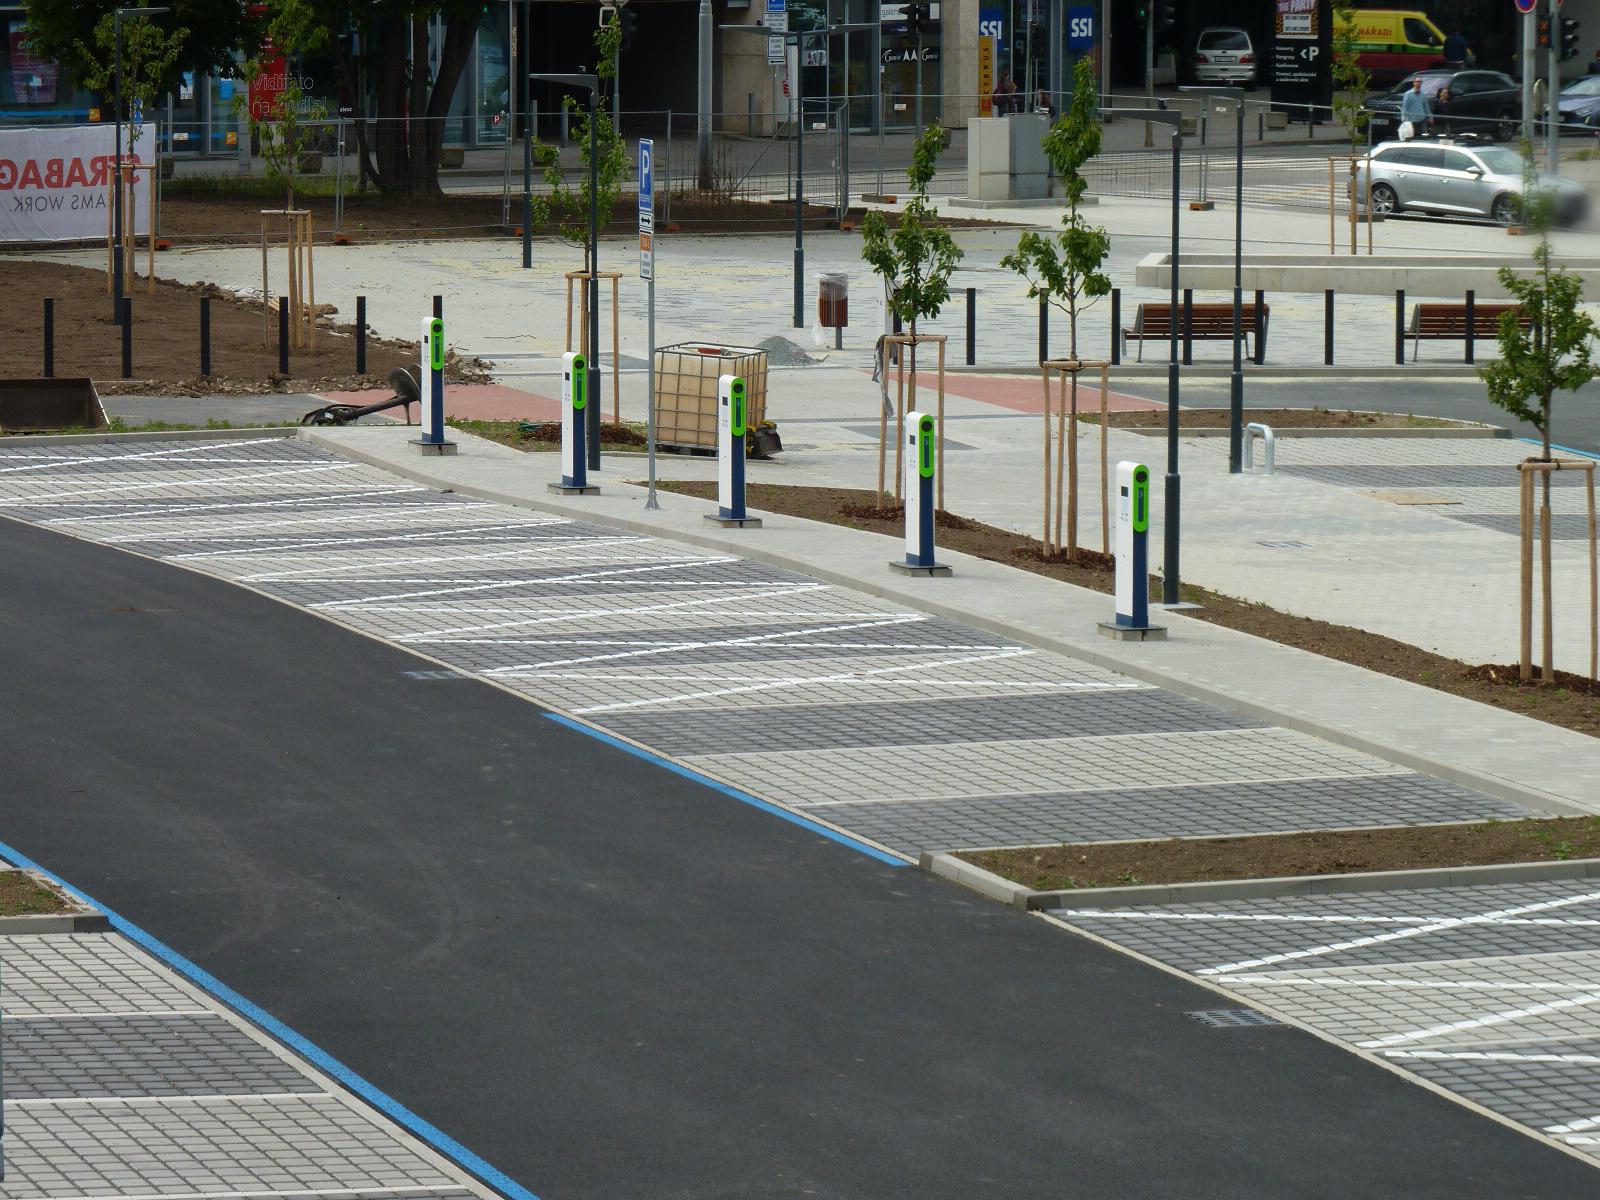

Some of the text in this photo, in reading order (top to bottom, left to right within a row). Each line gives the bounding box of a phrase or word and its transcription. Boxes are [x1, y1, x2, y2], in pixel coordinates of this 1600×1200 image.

[980, 20, 1002, 40] SSI
[1071, 18, 1093, 37] SSI
[1309, 46, 1319, 61] P
[643, 149, 650, 189] P
